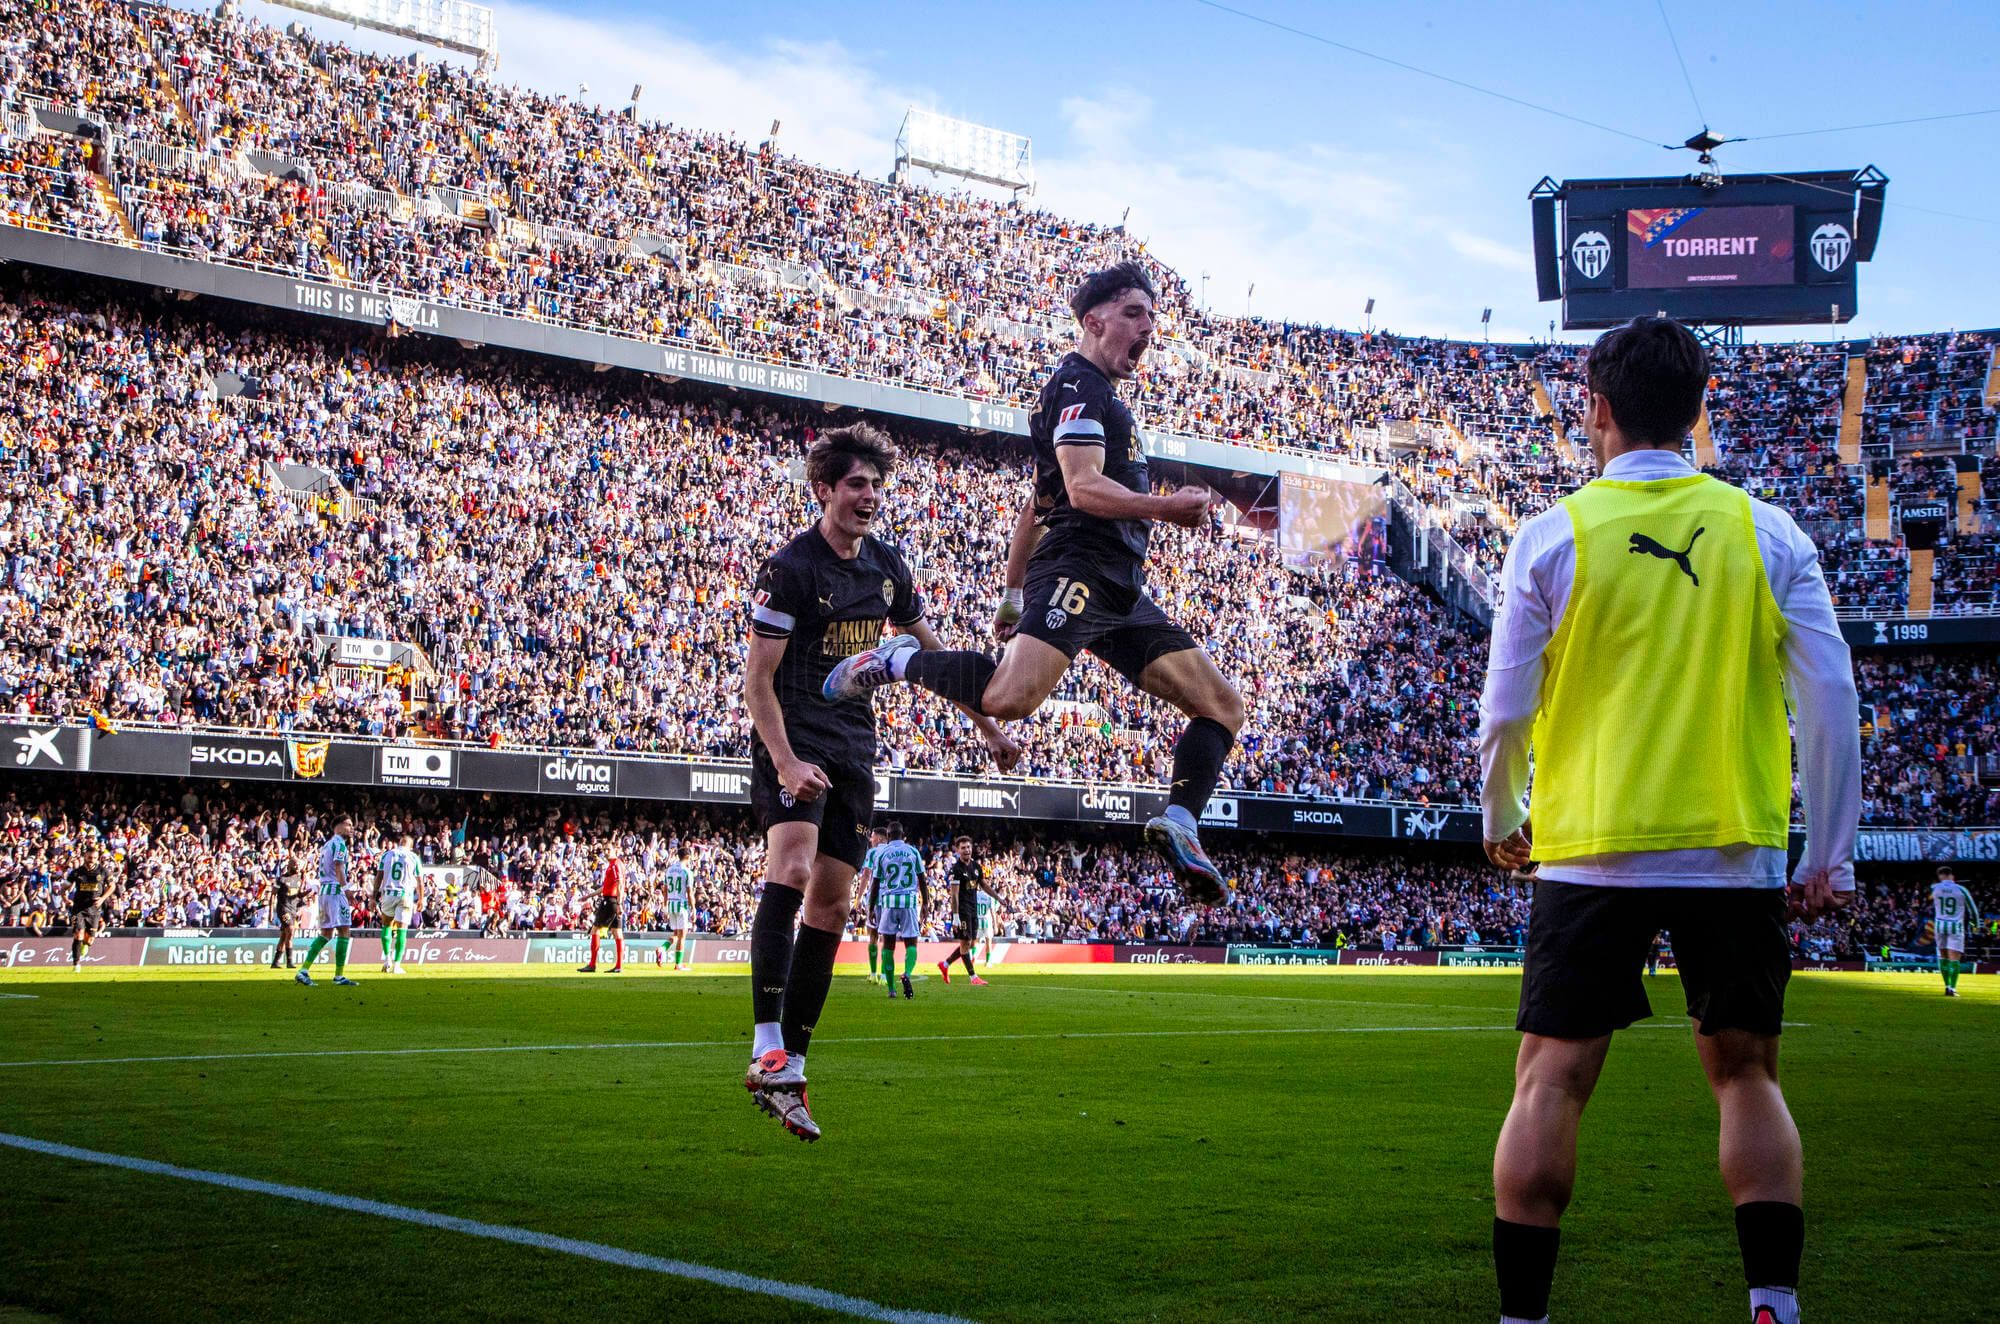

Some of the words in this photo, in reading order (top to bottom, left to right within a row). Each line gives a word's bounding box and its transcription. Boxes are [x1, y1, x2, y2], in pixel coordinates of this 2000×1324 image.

[1663, 236, 1759, 257] TORRENT
[295, 285, 333, 310] THIS
[338, 292, 355, 314] IS
[361, 297, 439, 329] MESLA
[664, 351, 686, 372] WE
[690, 356, 735, 380] THANK
[739, 364, 766, 386] OUR
[770, 370, 808, 393] FANS!
[986, 409, 1014, 428] 1979
[1902, 507, 1946, 518] AMSTEL
[1048, 576, 1090, 616] 16
[823, 619, 883, 642] AMUNT
[1891, 623, 1929, 641] 1999
[346, 643, 361, 654] TM
[387, 755, 410, 769] TM
[545, 757, 611, 783] divina
[381, 775, 393, 784] TM
[393, 776, 408, 785] Real
[408, 777, 429, 786] Estate
[430, 778, 450, 787] Group
[576, 782, 610, 794] seguros
[691, 771, 741, 794] PUMA
[959, 787, 1002, 809] PUMA
[1105, 811, 1130, 821] seguros
[1293, 810, 1344, 825] SKODA
[1859, 833, 1923, 861] CURVA
[391, 861, 403, 881] 6
[886, 861, 914, 890] 23
[667, 876, 682, 894] 34
[1938, 896, 1957, 916] 19
[168, 945, 232, 964] Nadie
[234, 947, 255, 964] te
[381, 942, 441, 965] nfe
[543, 945, 592, 963] Nadie
[598, 947, 614, 963] te
[1131, 948, 1170, 964] renfe
[1239, 953, 1272, 965] Nadie
[1274, 955, 1287, 965] te
[1289, 954, 1304, 965] da
[1306, 954, 1328, 966] más
[1356, 953, 1390, 967] renfe
[1448, 957, 1479, 967] Nadie
[1480, 957, 1492, 967] te
[1494, 957, 1506, 968] da
